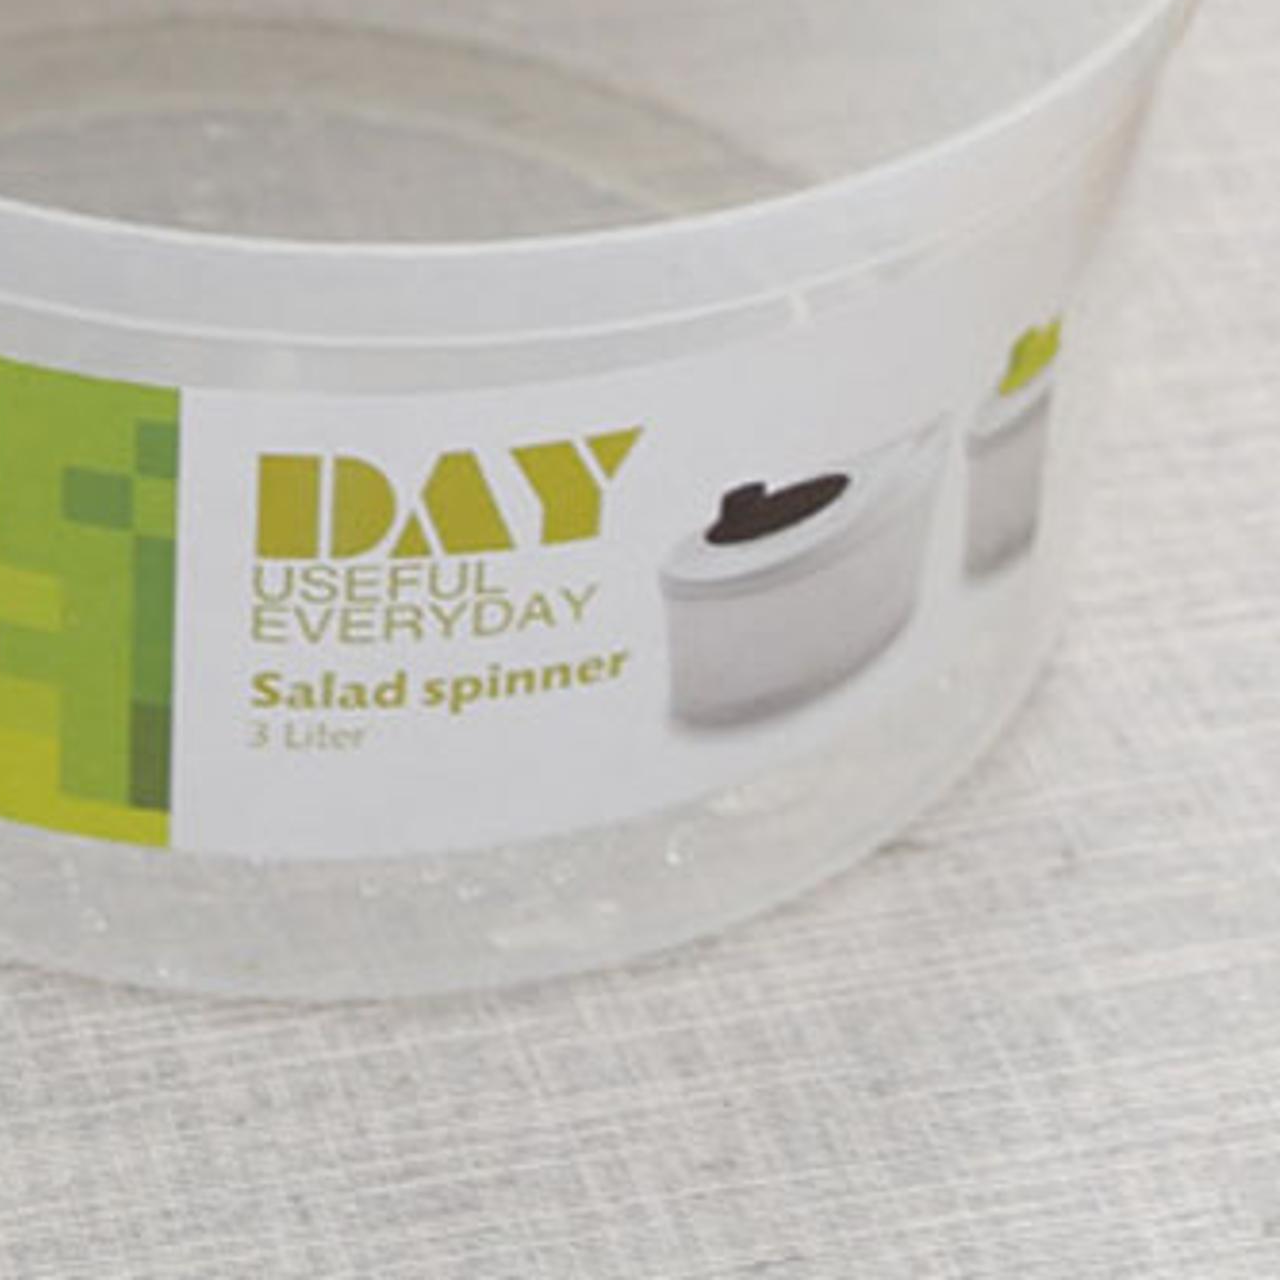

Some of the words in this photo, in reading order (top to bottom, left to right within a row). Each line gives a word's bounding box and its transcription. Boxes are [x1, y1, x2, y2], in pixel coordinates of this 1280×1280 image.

[255, 426, 644, 558] DAY
[253, 559, 507, 604] USEFUL
[251, 586, 599, 644] EVERYDAY
[251, 669, 407, 709] Salad
[421, 647, 630, 714] spinner
[248, 720, 271, 750] 3
[284, 720, 368, 751] Liter
